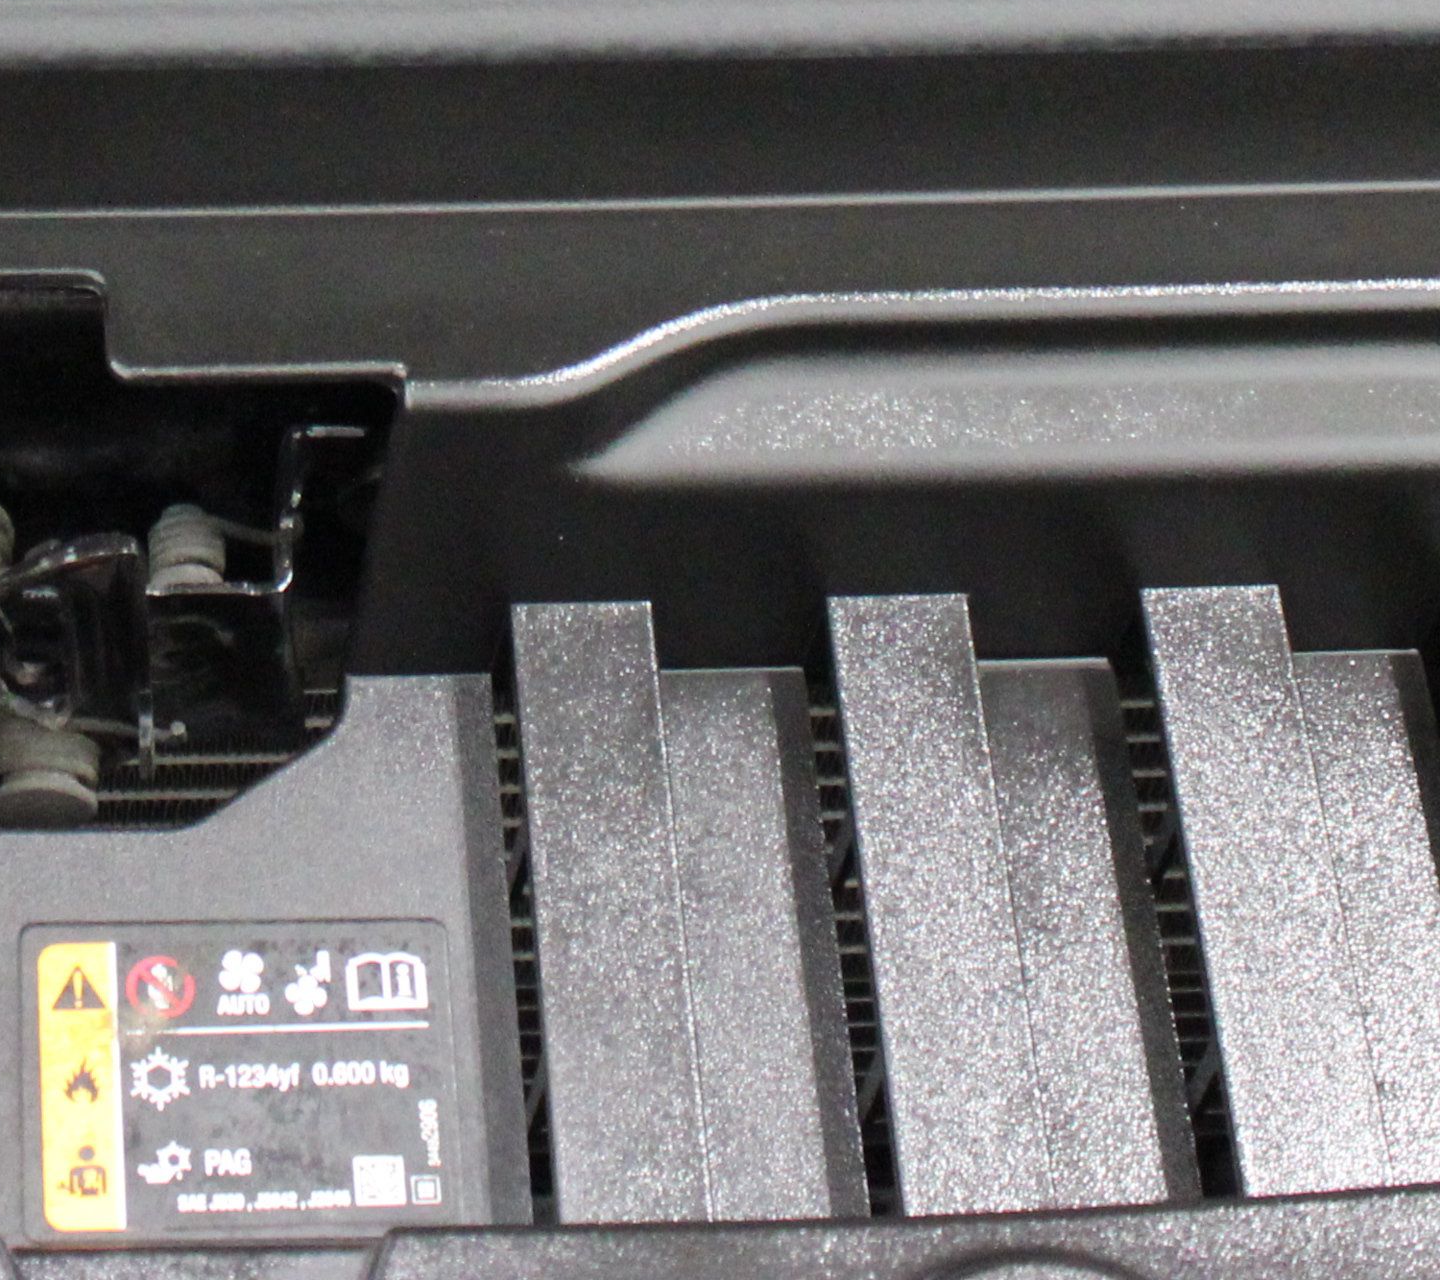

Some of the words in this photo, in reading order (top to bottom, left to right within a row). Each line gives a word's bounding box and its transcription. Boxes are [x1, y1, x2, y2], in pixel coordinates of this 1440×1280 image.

[216, 993, 271, 1016] AUTO
[198, 1062, 301, 1092] R-1234yf
[379, 1059, 410, 1089] kg
[204, 1147, 252, 1177] PAG
